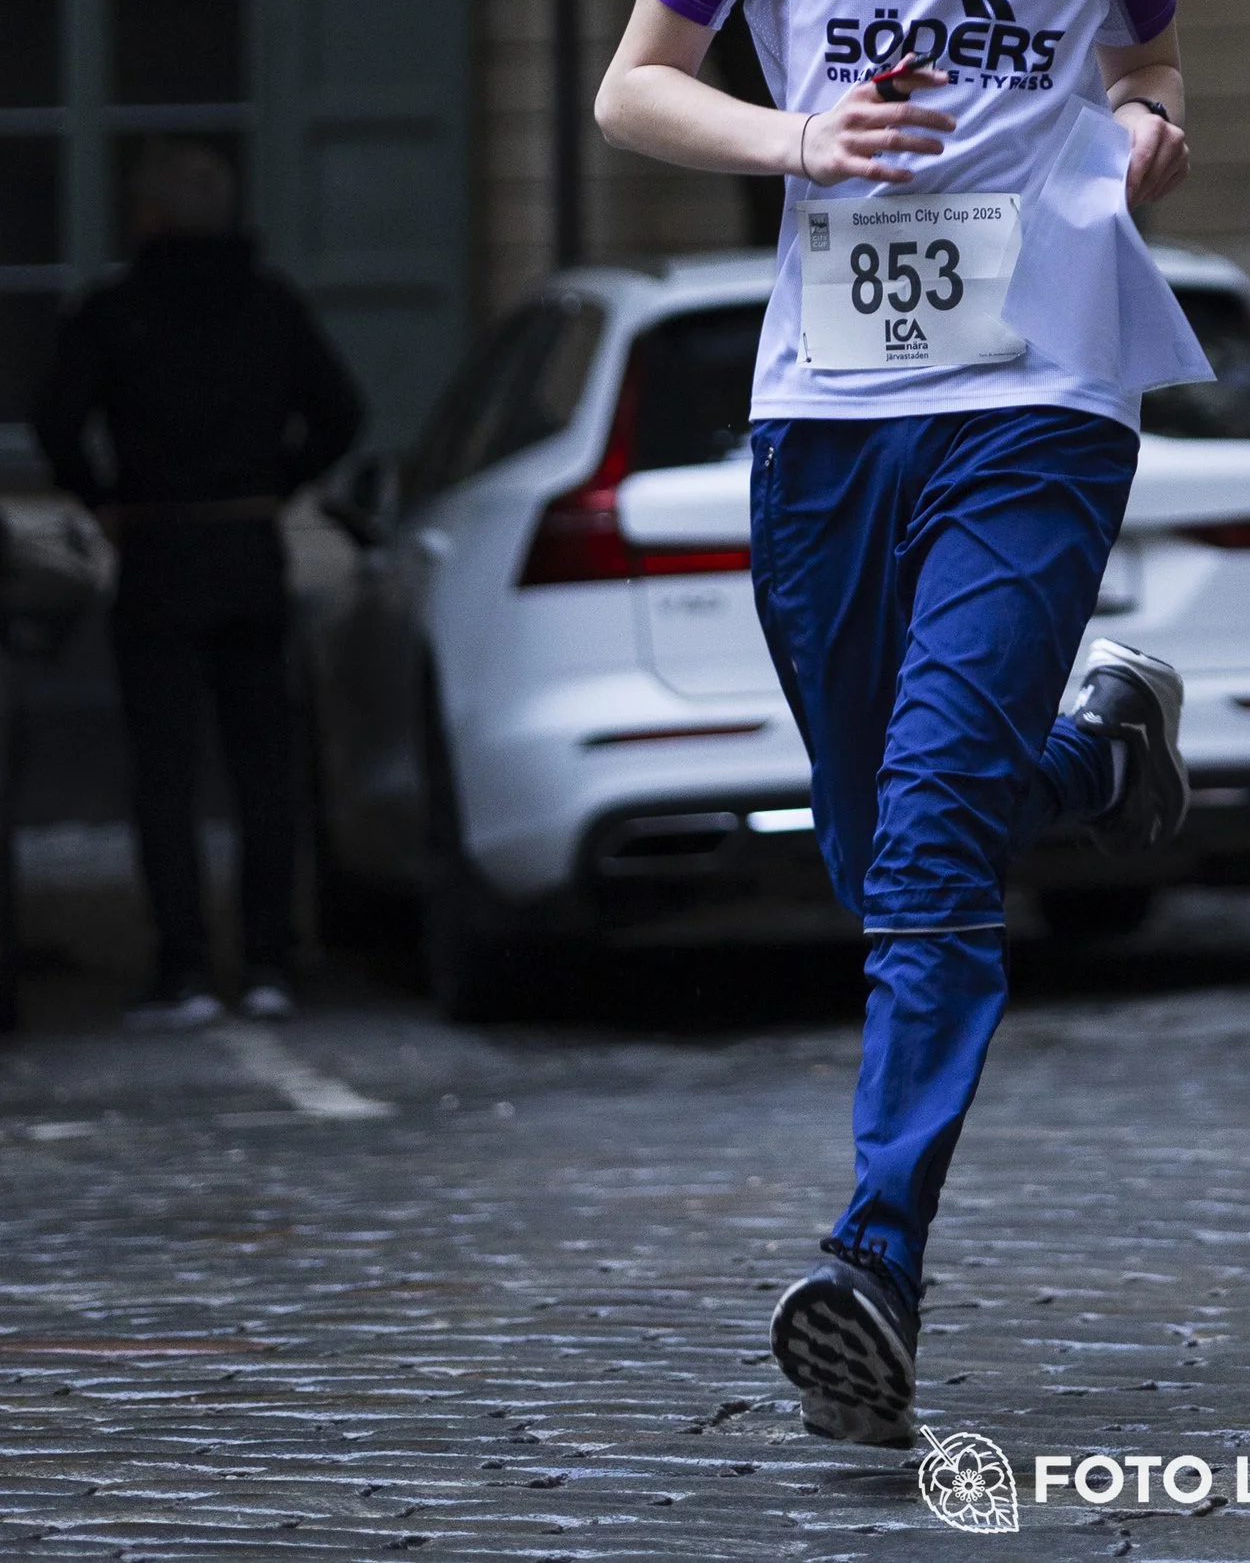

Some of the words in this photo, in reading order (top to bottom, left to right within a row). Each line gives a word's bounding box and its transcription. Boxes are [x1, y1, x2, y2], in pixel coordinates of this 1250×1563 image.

[825, 8, 1066, 73] SÖDERS
[852, 210, 912, 226] Stockholm
[915, 209, 940, 225] City
[943, 208, 969, 222] Cup
[972, 207, 1002, 221] 2025
[850, 238, 964, 315] 853
[885, 318, 927, 342] ICA
[885, 351, 929, 362] järvastaden
[906, 342, 929, 350] nära
